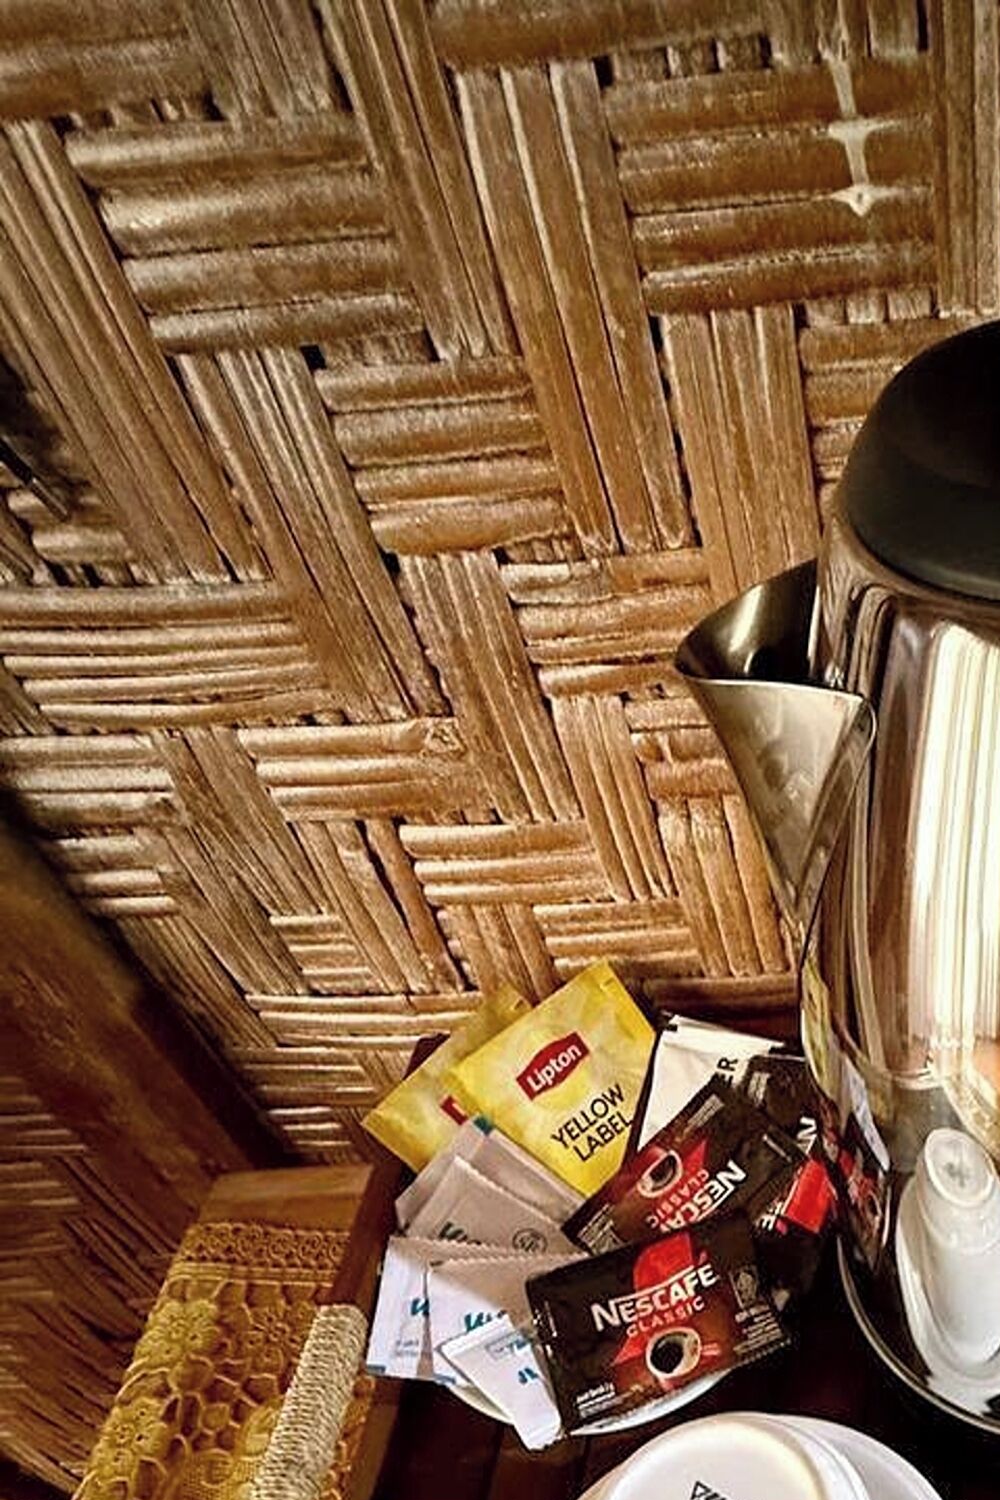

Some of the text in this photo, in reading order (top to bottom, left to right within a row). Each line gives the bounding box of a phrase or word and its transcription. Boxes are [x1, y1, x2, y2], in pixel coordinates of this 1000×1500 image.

[526, 1045, 582, 1091] Lipton
[551, 1083, 625, 1149] YELLOW
[573, 1111, 633, 1162] LABEL
[648, 1170, 710, 1229] CLASSIC
[667, 1159, 747, 1233] NESCA
[626, 1295, 706, 1337] CLASSIC
